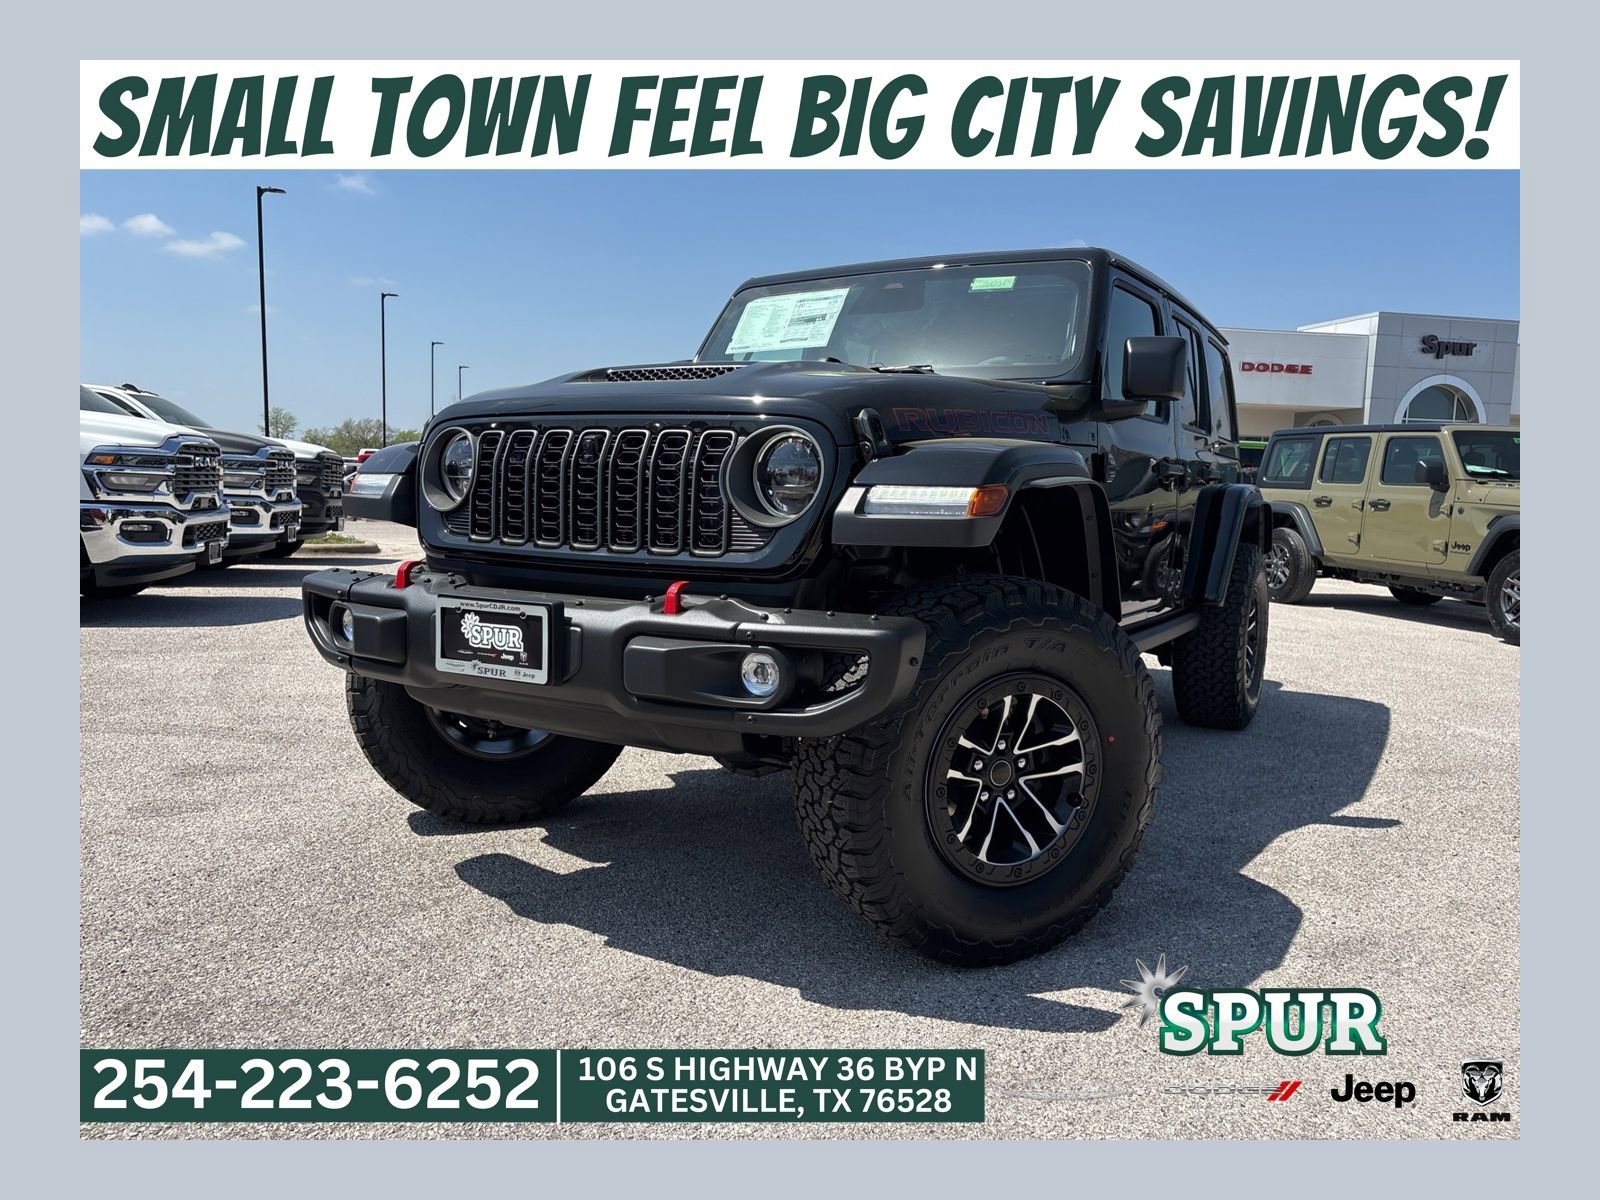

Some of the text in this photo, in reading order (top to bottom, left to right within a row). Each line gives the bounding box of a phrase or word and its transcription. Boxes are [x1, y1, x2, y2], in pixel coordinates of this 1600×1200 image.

[1421, 334, 1477, 359] Spur
[1240, 361, 1313, 375] DODGE
[892, 407, 1051, 436] RUBICON
[1451, 543, 1472, 552] Jeep
[460, 602, 520, 611] www.SpurCDJR.com
[470, 624, 523, 650] SPUR
[1024, 638, 1066, 651] T/A
[501, 653, 514, 661] Jeep
[477, 667, 506, 677] SPUR
